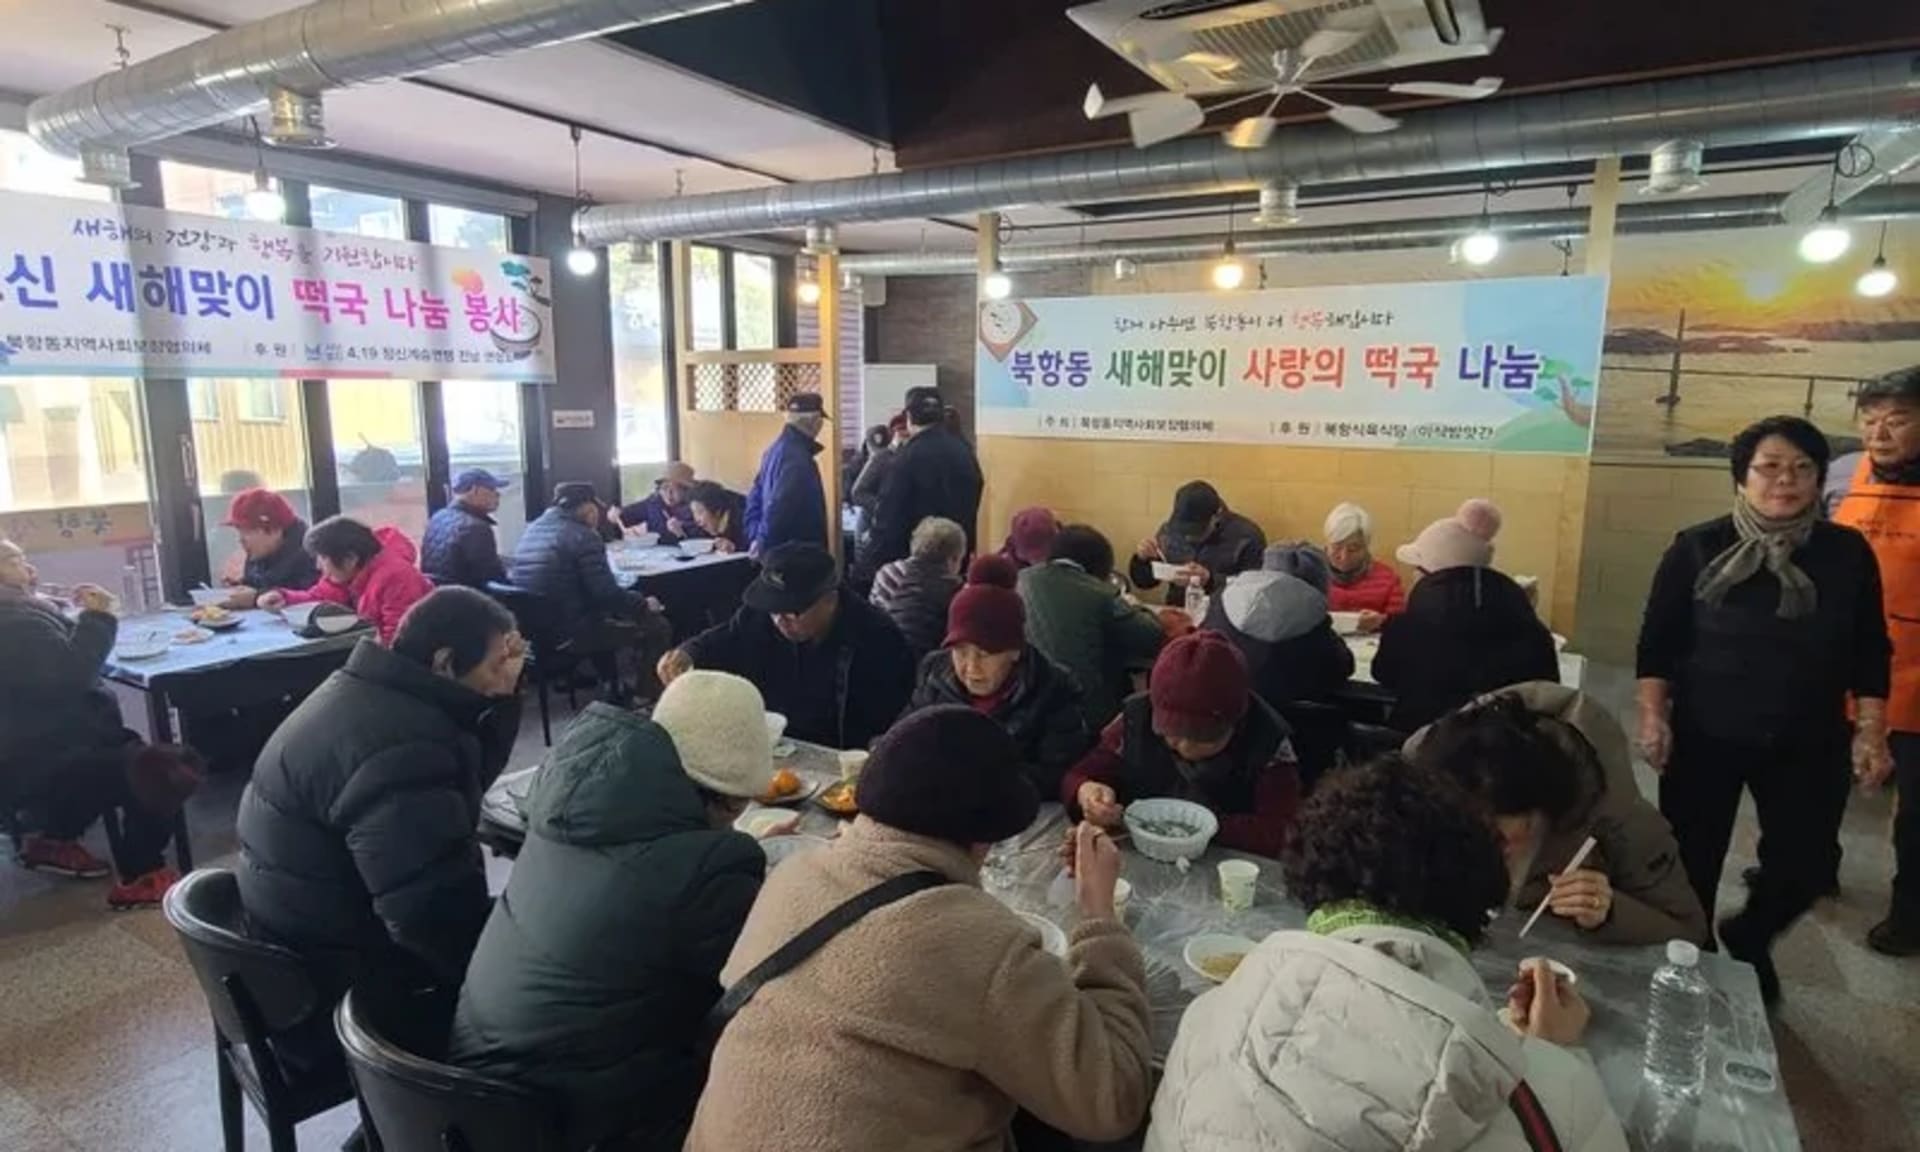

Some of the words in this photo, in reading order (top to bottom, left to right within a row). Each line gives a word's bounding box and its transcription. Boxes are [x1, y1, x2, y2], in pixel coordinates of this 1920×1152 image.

[165, 229, 238, 253] 건강과
[324, 246, 418, 272] 기원합니다
[0, 253, 59, 309] 신
[86, 261, 275, 321] 새해맞이
[293, 279, 369, 325] 떡국
[384, 287, 450, 331] 나눔
[464, 293, 523, 334] 봉사
[1011, 349, 1092, 387] 북항동
[1104, 348, 1228, 388] 새해맞이
[1242, 347, 1346, 390] 사랑의
[1364, 346, 1440, 389] 떡국
[1458, 344, 1541, 389] 나눔
